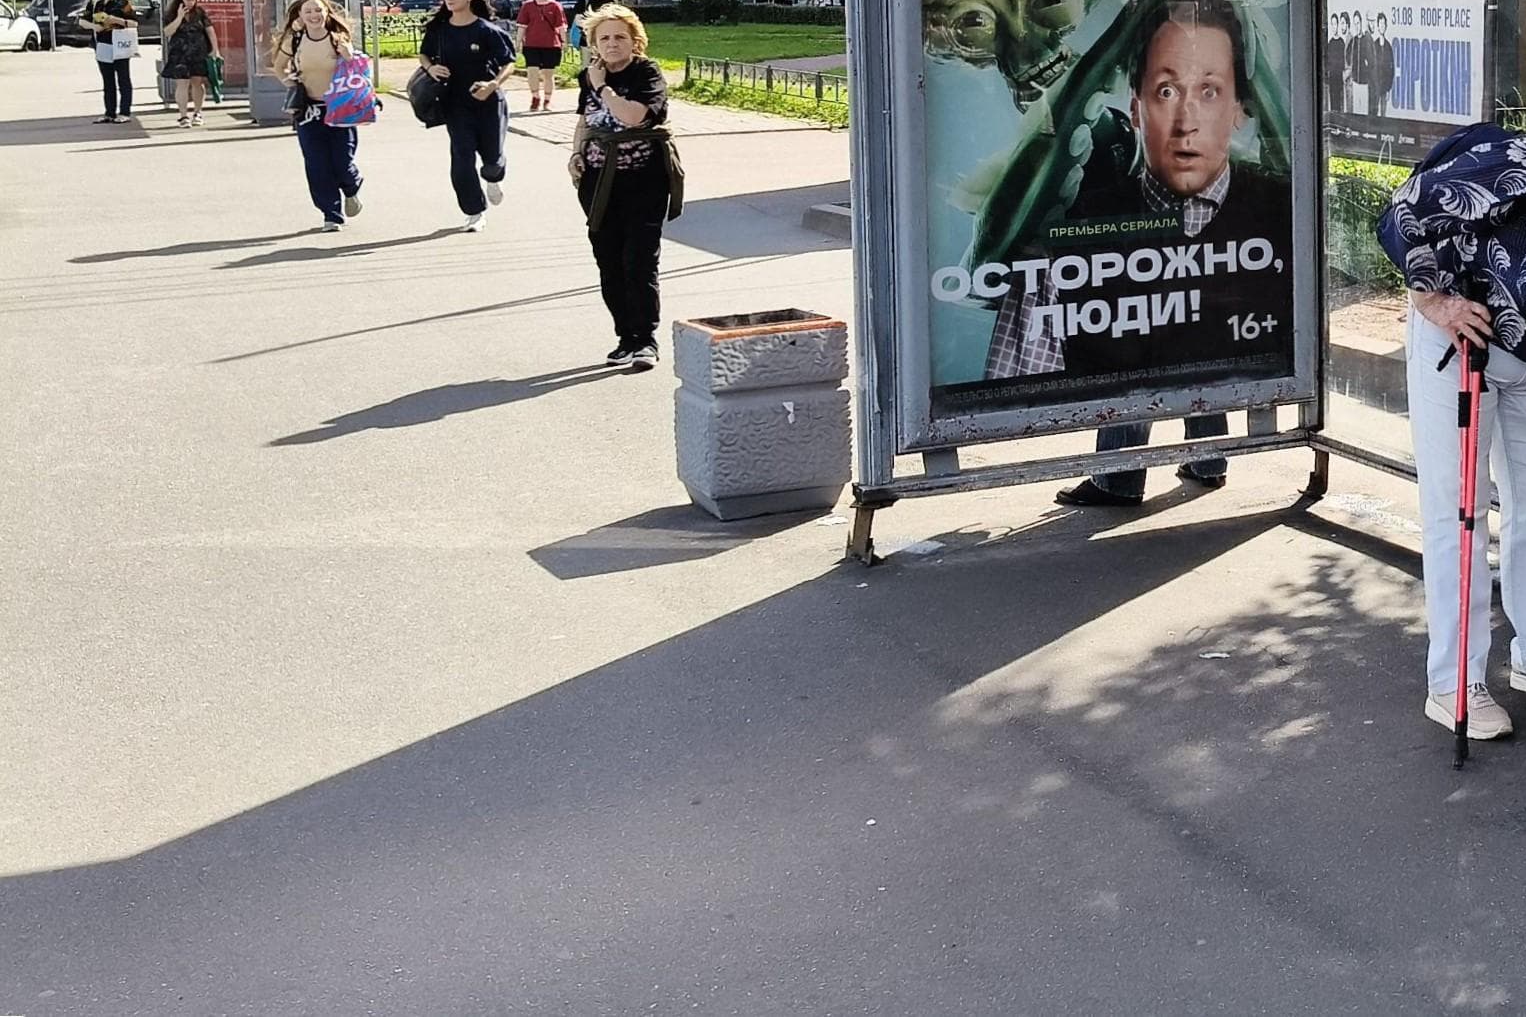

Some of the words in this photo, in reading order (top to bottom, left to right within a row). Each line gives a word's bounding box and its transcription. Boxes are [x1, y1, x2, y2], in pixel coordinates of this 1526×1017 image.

[1391, 7, 1413, 26] 31.08
[1420, 7, 1442, 27] ROOF
[1444, 7, 1471, 28] PLACE
[1391, 38, 1472, 117] СИРОТКИН
[1049, 222, 1118, 238] ПРЕМЬЕРА
[1121, 217, 1178, 232] СЕРИАЛА
[931, 238, 1284, 302] ОСТОРОЖНО,
[1028, 289, 1201, 341] ЛЮДИ!
[1227, 312, 1278, 342] 16+
